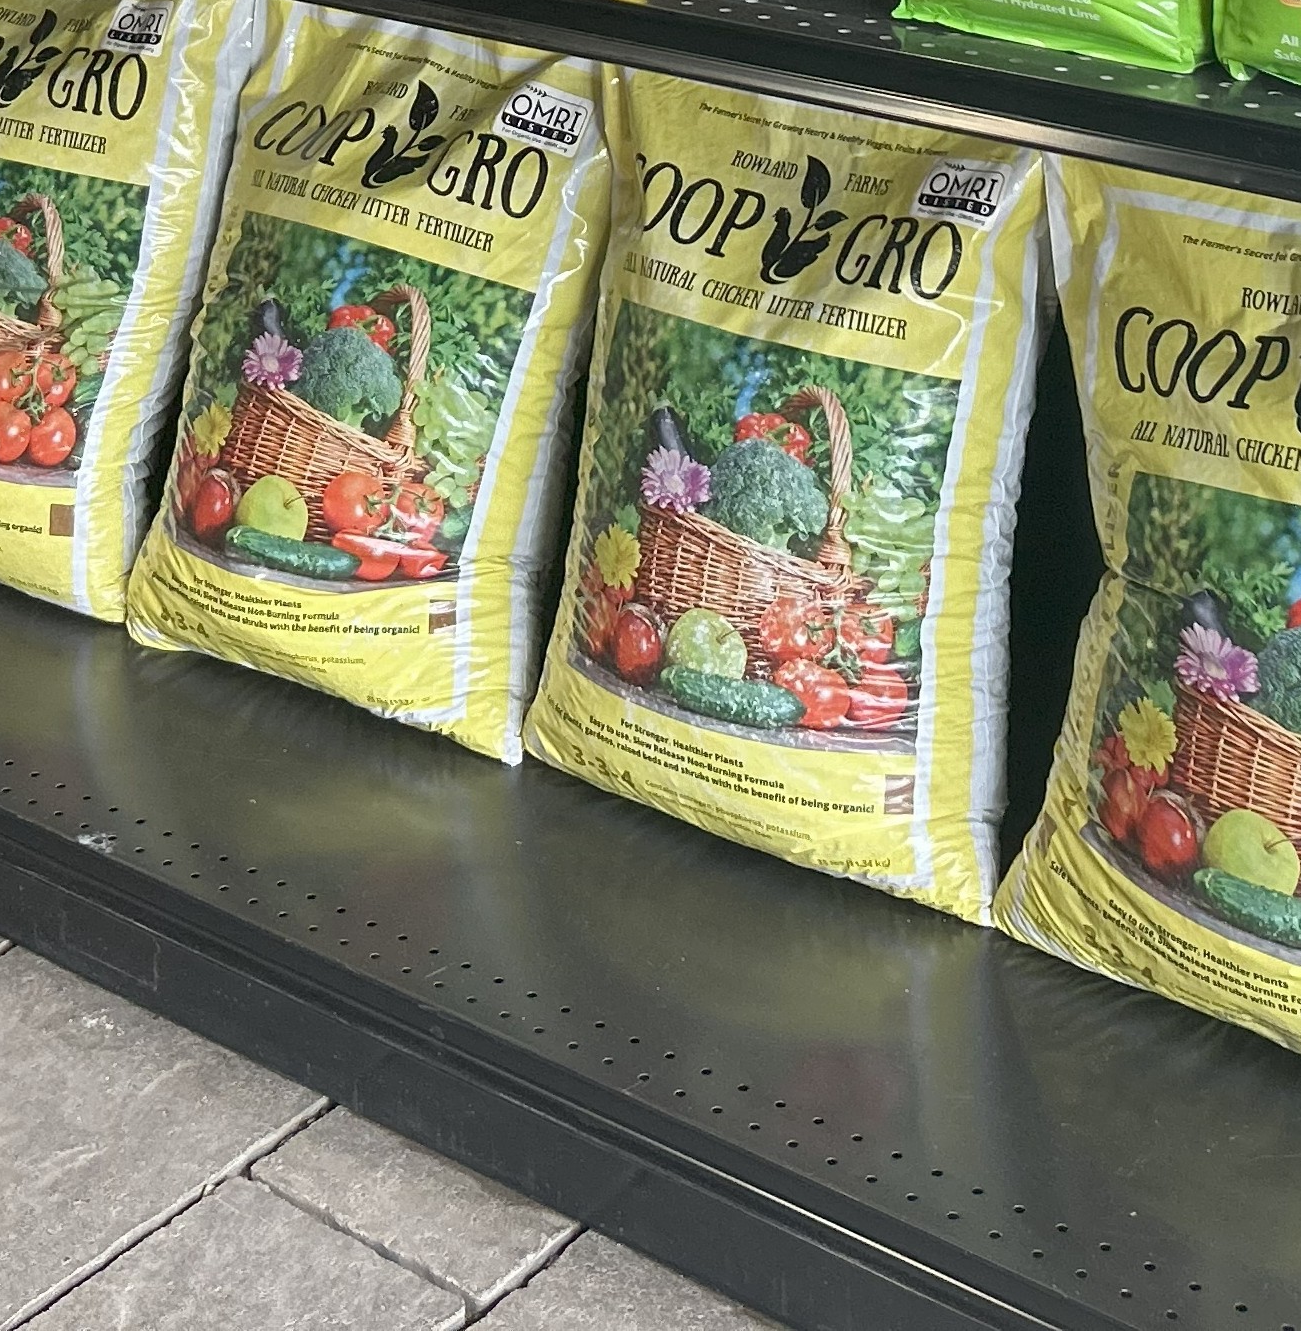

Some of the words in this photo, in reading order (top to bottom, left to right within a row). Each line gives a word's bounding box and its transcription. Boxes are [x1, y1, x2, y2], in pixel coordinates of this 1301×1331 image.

[1281, 34, 1299, 47] All
[47, 46, 148, 122] GRO
[510, 92, 584, 134] OMRI
[39, 124, 107, 155] FERTILIZER
[252, 99, 375, 168] COOP
[426, 128, 549, 220] GRO
[927, 171, 999, 204] OMRI
[414, 211, 494, 253] FERTILIZER
[833, 213, 963, 300] GRO
[701, 278, 764, 310] CHICKEN
[766, 295, 816, 323] LITTER
[816, 303, 909, 341] FERTILIZER
[1114, 305, 1291, 411] COOP
[1130, 418, 1155, 444] ALL
[1161, 423, 1231, 459] NATURAL
